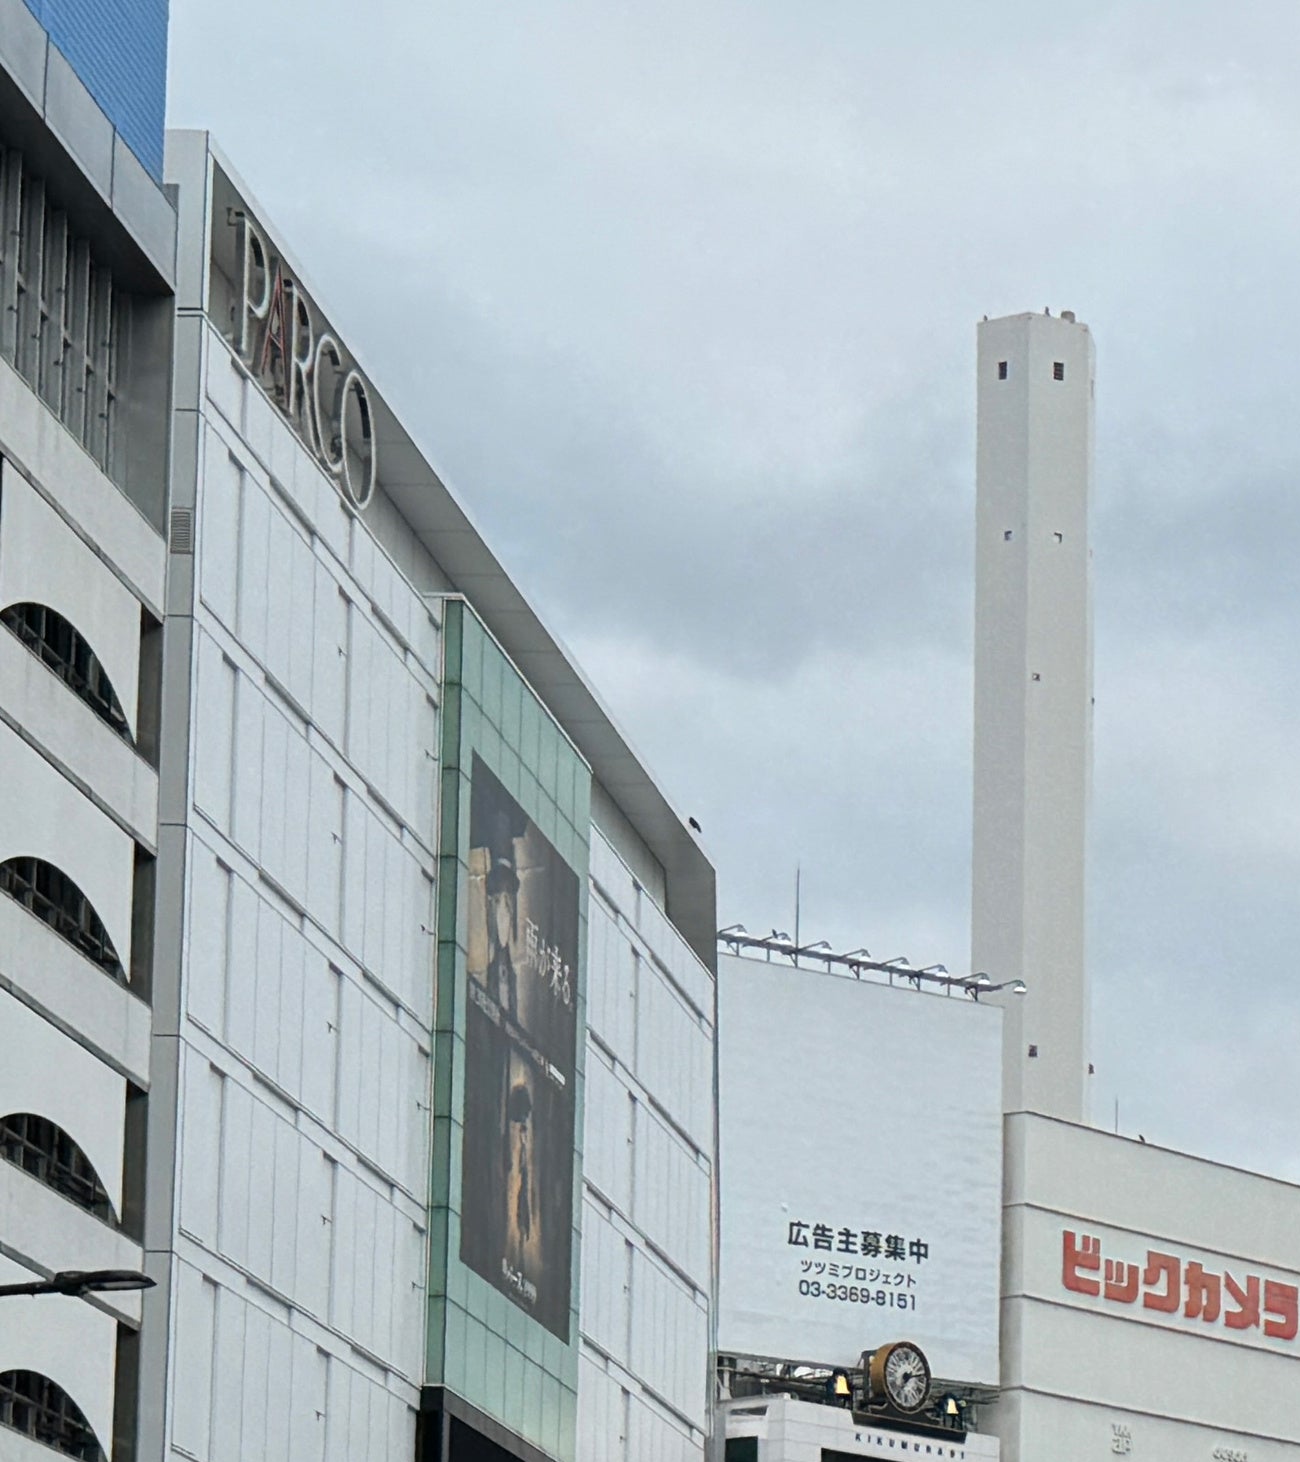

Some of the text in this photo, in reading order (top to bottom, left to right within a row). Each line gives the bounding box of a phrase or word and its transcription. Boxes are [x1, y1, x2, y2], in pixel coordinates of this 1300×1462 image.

[232, 208, 376, 510] PARCO
[787, 1220, 930, 1265] 広告主募集中
[798, 1279, 918, 1311] 03-3369-8151
[799, 1259, 918, 1290] ツツミプロジェクト
[1061, 1229, 1300, 1341] ビックカメラ
